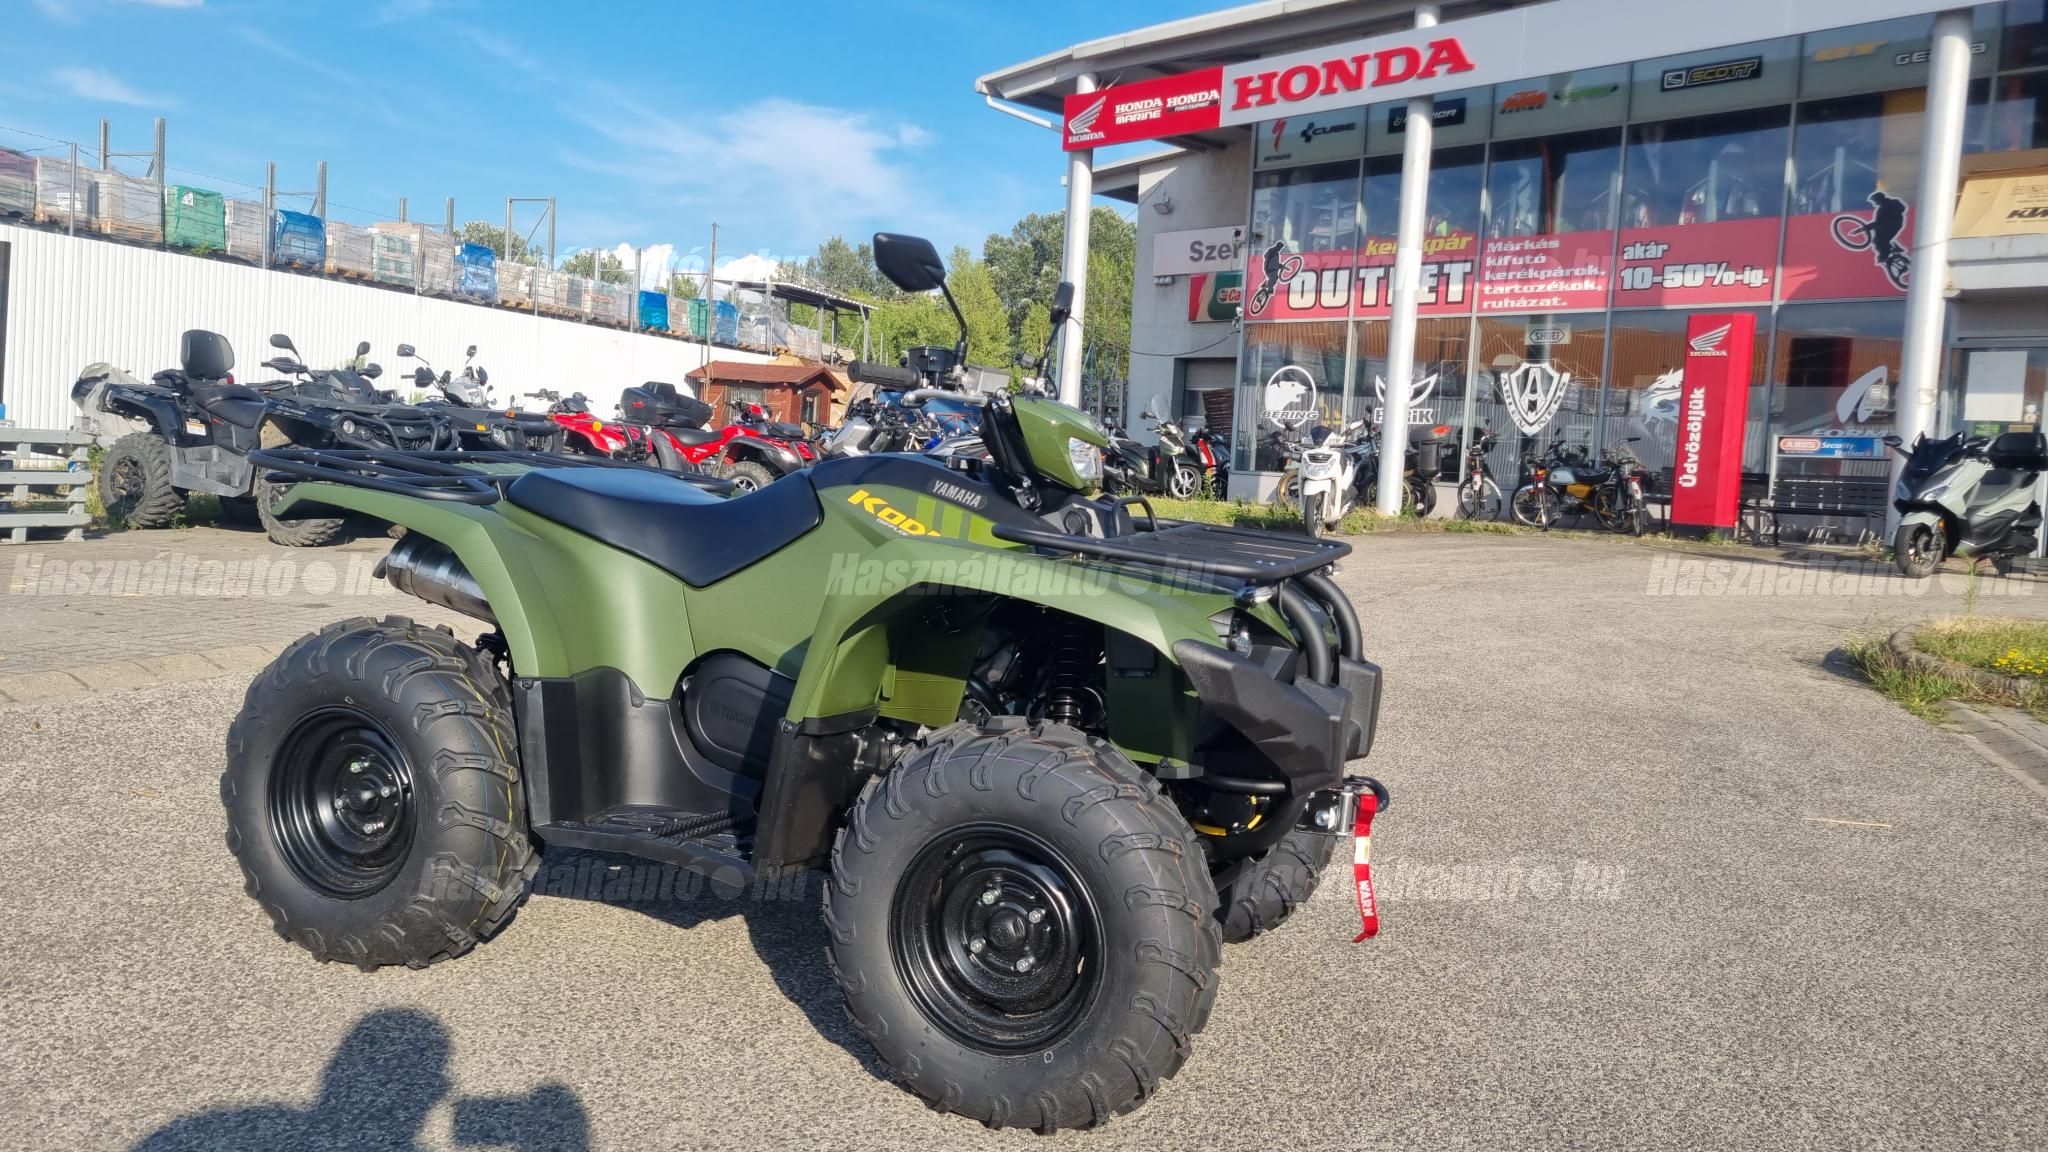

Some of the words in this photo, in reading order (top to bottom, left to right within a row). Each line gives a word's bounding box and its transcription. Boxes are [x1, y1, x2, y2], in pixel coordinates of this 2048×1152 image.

[1230, 37, 1476, 111] HONDA
[1689, 61, 1757, 84] SCOTT
[1115, 98, 1163, 113] HONDA
[1166, 89, 1220, 107] HONDA
[1115, 110, 1161, 124] MARINE
[1068, 132, 1105, 143] HONDA
[1312, 123, 1357, 136] CUBE
[1487, 238, 1560, 252] Márkás
[1622, 242, 1669, 261] akár
[1485, 252, 1546, 267] kifutó
[1484, 265, 1607, 281] kerékpárok,
[1620, 261, 1770, 291] 10-50%-ig.
[1287, 261, 1473, 311] OUTET
[1483, 280, 1602, 295] tartozékok,
[1482, 295, 1568, 309] ruházat.
[1260, 410, 1320, 420] BERING
[1678, 386, 1707, 488] Üdvözöljük
[932, 480, 982, 508] YAMAHA
[1358, 879, 1375, 918] WARN
